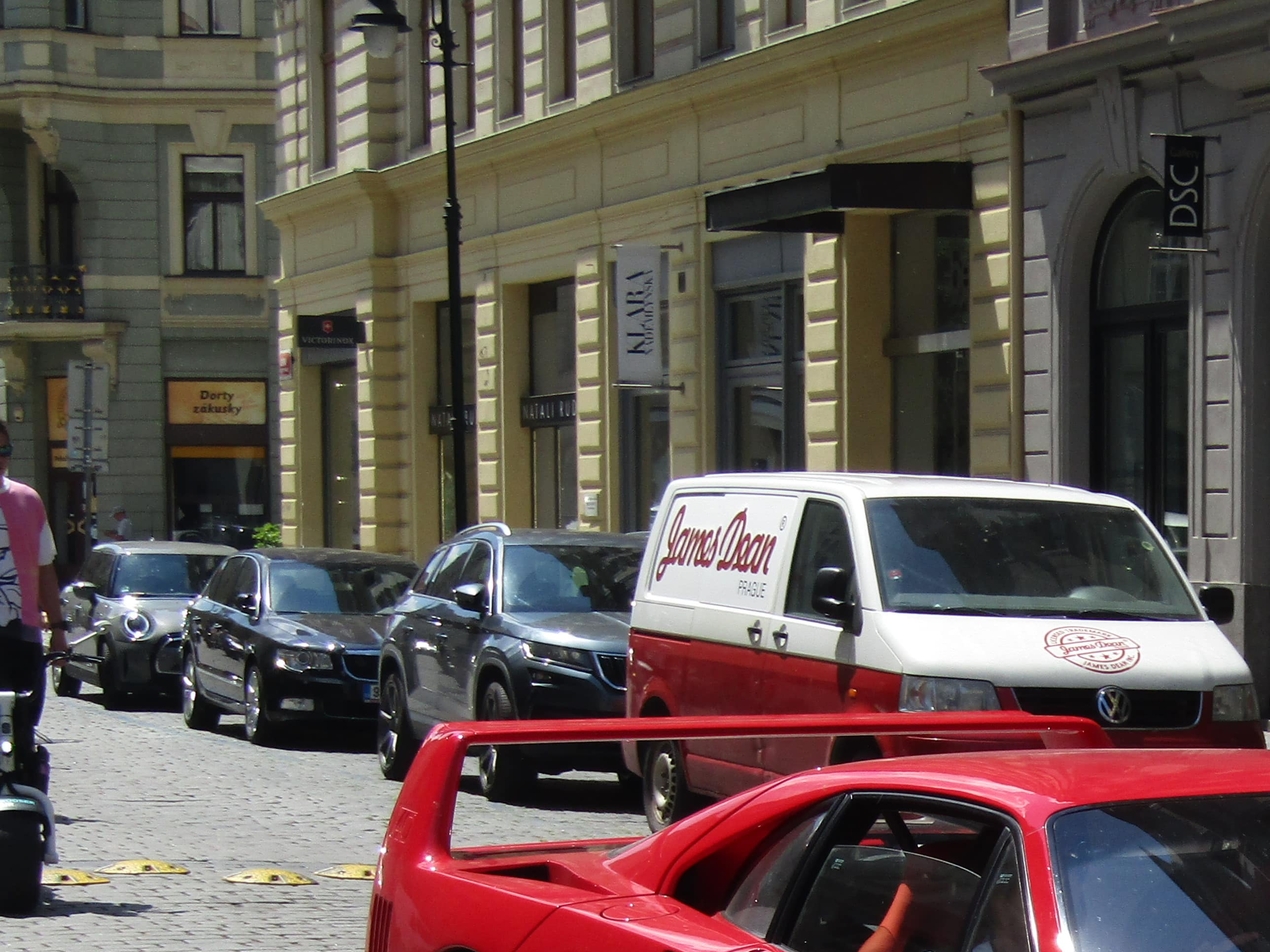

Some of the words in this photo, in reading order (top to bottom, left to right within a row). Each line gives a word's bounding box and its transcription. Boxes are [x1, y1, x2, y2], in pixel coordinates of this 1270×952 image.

[1169, 164, 1198, 227] DSC
[625, 270, 646, 354] KLARA
[301, 336, 355, 344] VICTORINOX
[200, 390, 234, 402] Dorty
[193, 403, 242, 416] zákusky
[655, 504, 722, 582] James
[716, 507, 777, 576] Dean
[737, 579, 768, 599] PRAGUE
[1059, 643, 1096, 655] James
[1095, 640, 1126, 650] Dean
[1082, 660, 1109, 670] JAMES
[1110, 660, 1129, 670] DEAN
